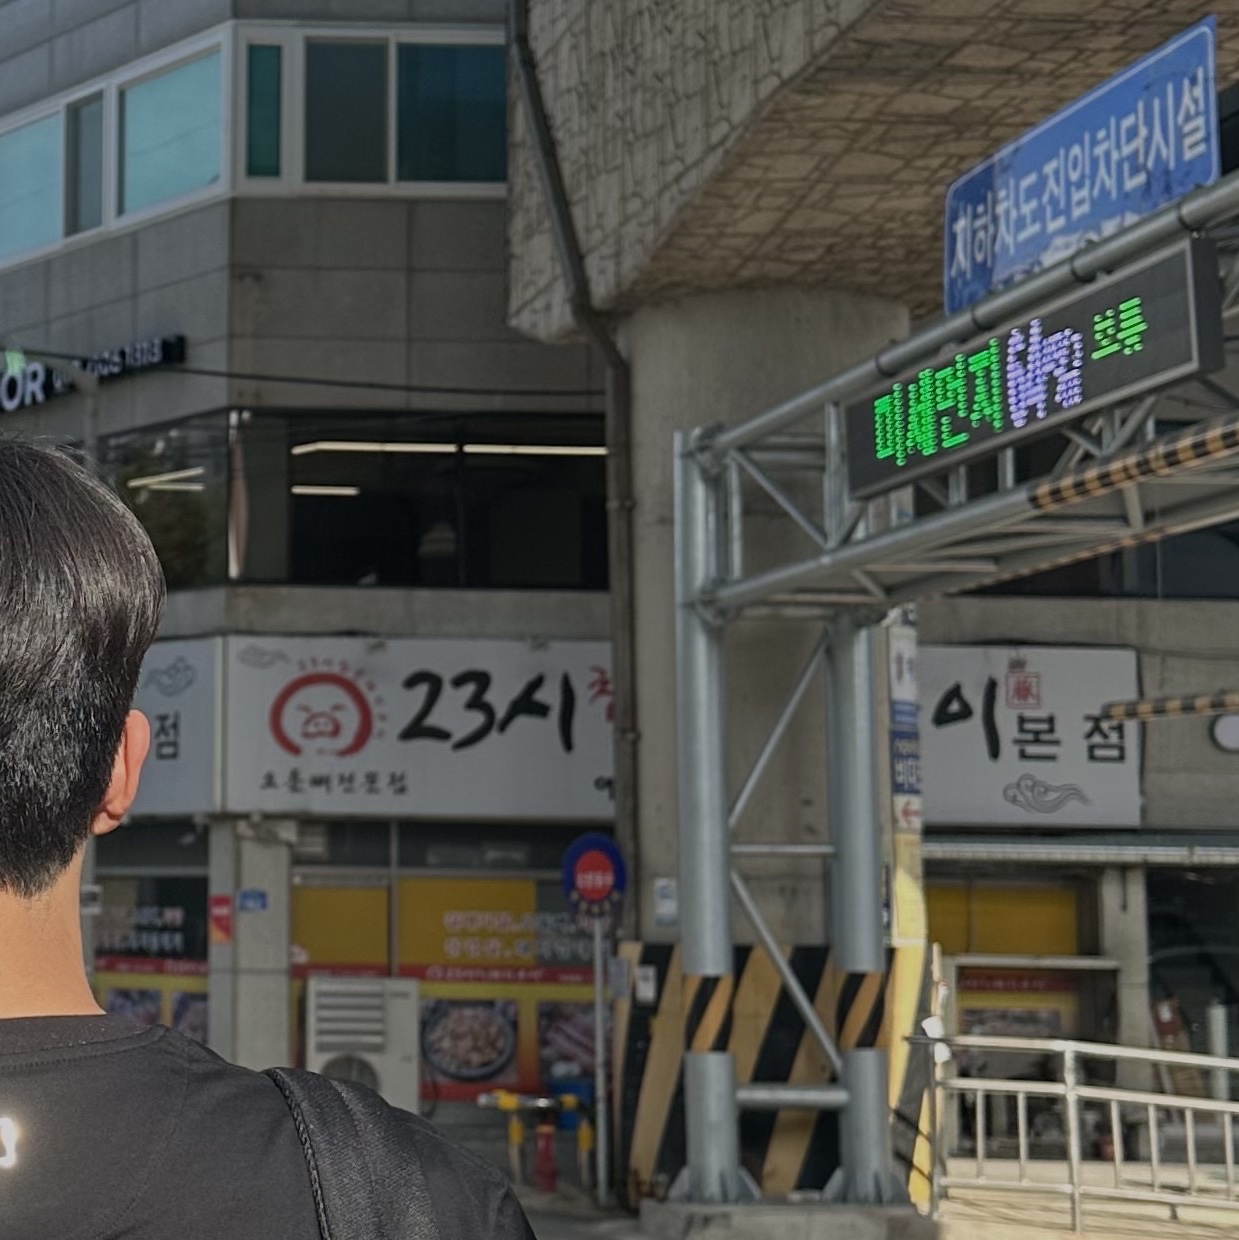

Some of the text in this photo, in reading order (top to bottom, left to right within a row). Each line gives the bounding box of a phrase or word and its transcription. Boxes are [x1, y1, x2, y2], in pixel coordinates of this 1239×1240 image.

[950, 66, 1208, 281] 지하차도진입차단시설
[874, 337, 1003, 467] 미세먼지
[153, 709, 181, 761] 점
[397, 669, 576, 754] 23시
